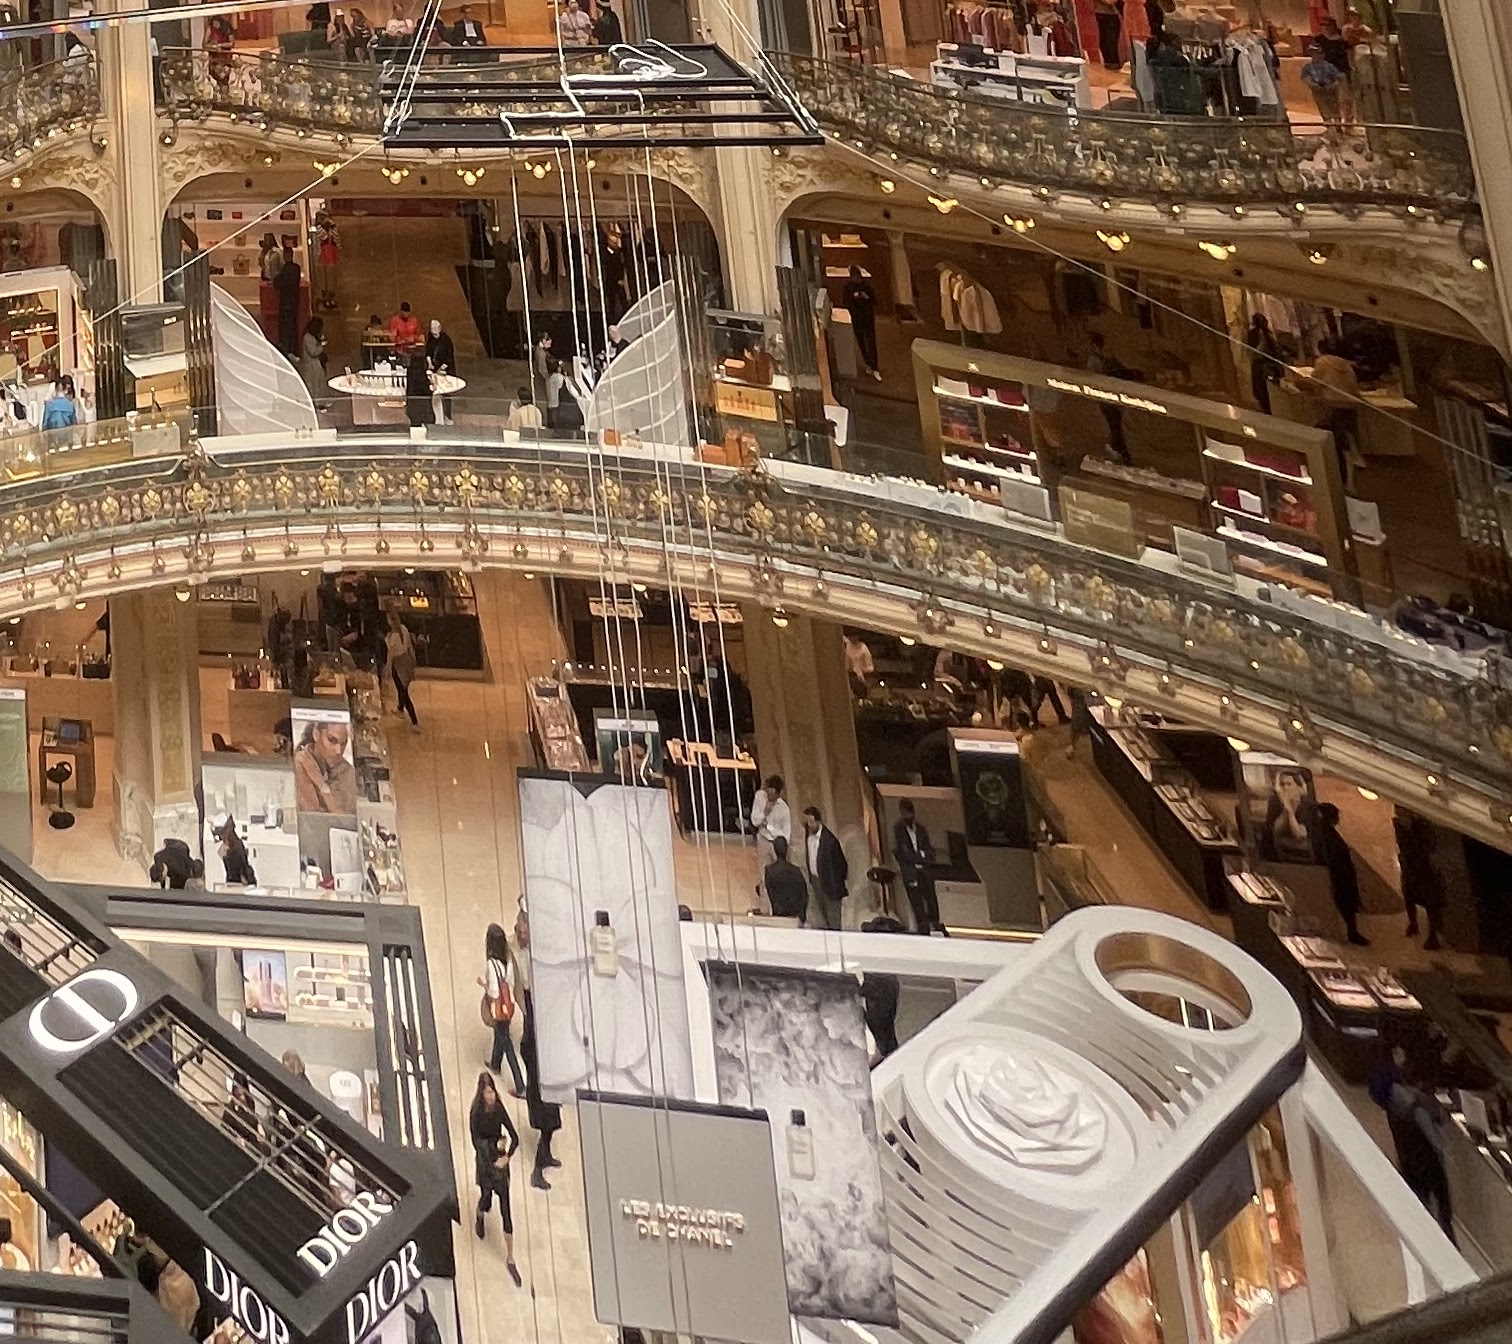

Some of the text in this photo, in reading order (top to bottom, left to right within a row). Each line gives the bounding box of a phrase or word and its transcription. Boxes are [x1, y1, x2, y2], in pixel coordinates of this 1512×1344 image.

[295, 1190, 394, 1279] DIOR
[202, 1246, 291, 1344] DIOR
[345, 1240, 422, 1344] DIOR
